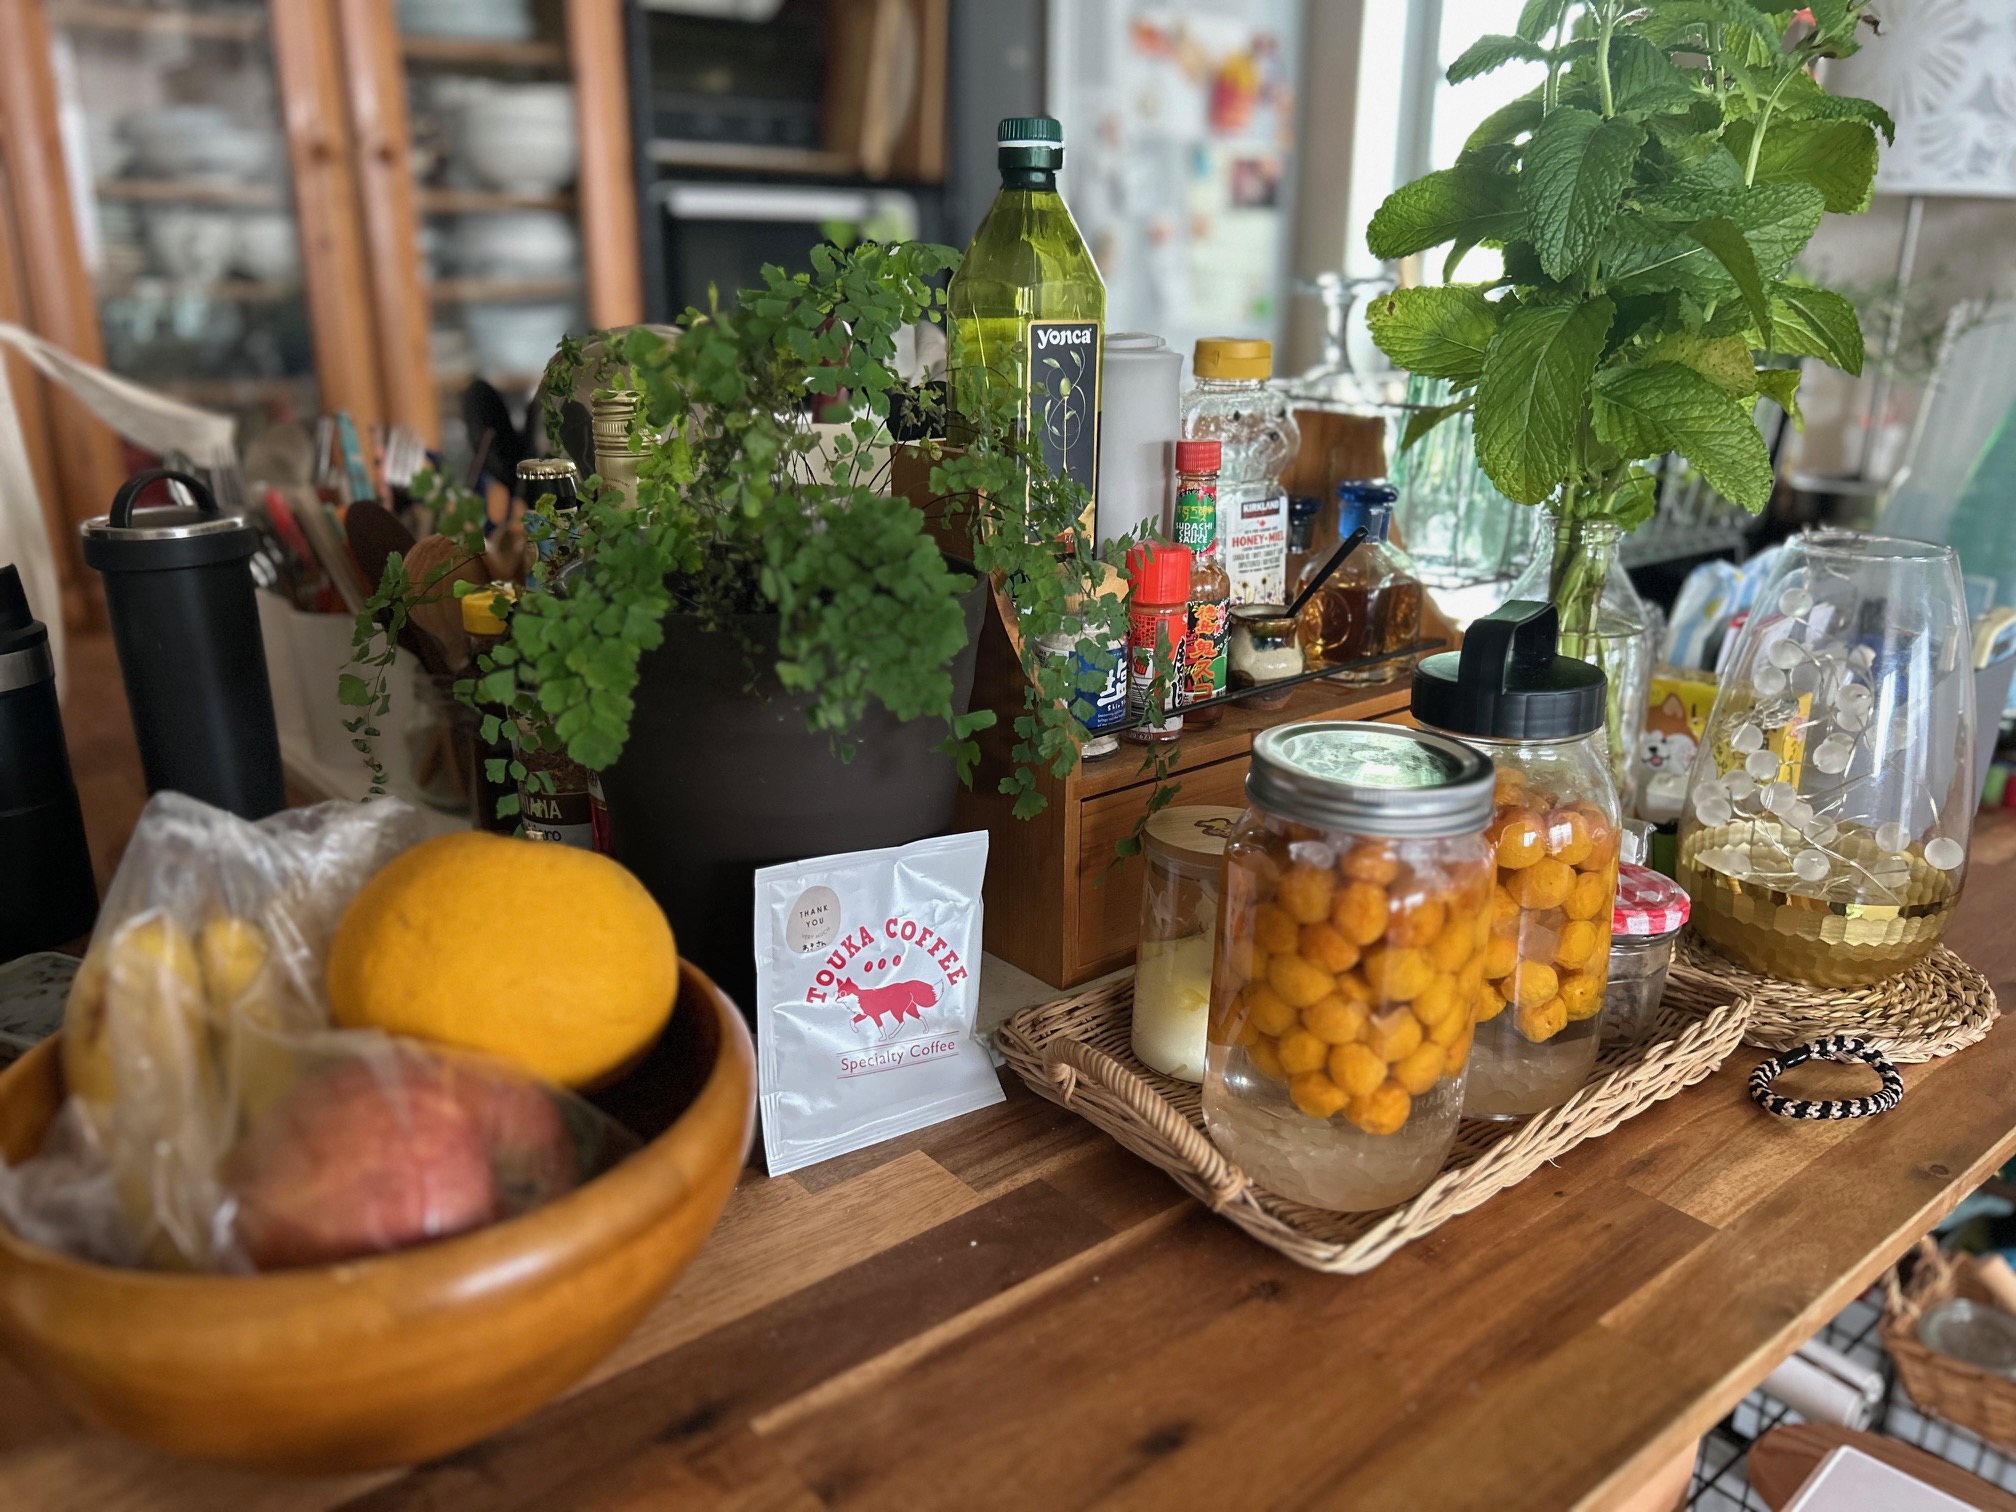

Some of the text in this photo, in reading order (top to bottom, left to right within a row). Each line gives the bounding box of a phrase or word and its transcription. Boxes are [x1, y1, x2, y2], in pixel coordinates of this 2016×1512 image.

[1037, 328, 1091, 350] yonca
[1242, 500, 1279, 514] KIRKLAND
[1175, 522, 1213, 530] SUDACHI
[1178, 536, 1208, 544] SAUCE
[1231, 536, 1264, 548] HONEY
[1268, 530, 1284, 543] MIEL
[799, 904, 829, 919] THANK
[805, 917, 824, 928] YOU
[805, 917, 969, 1004] TOUKA COFFEE
[840, 1039, 956, 1073] Specialty Coffee
